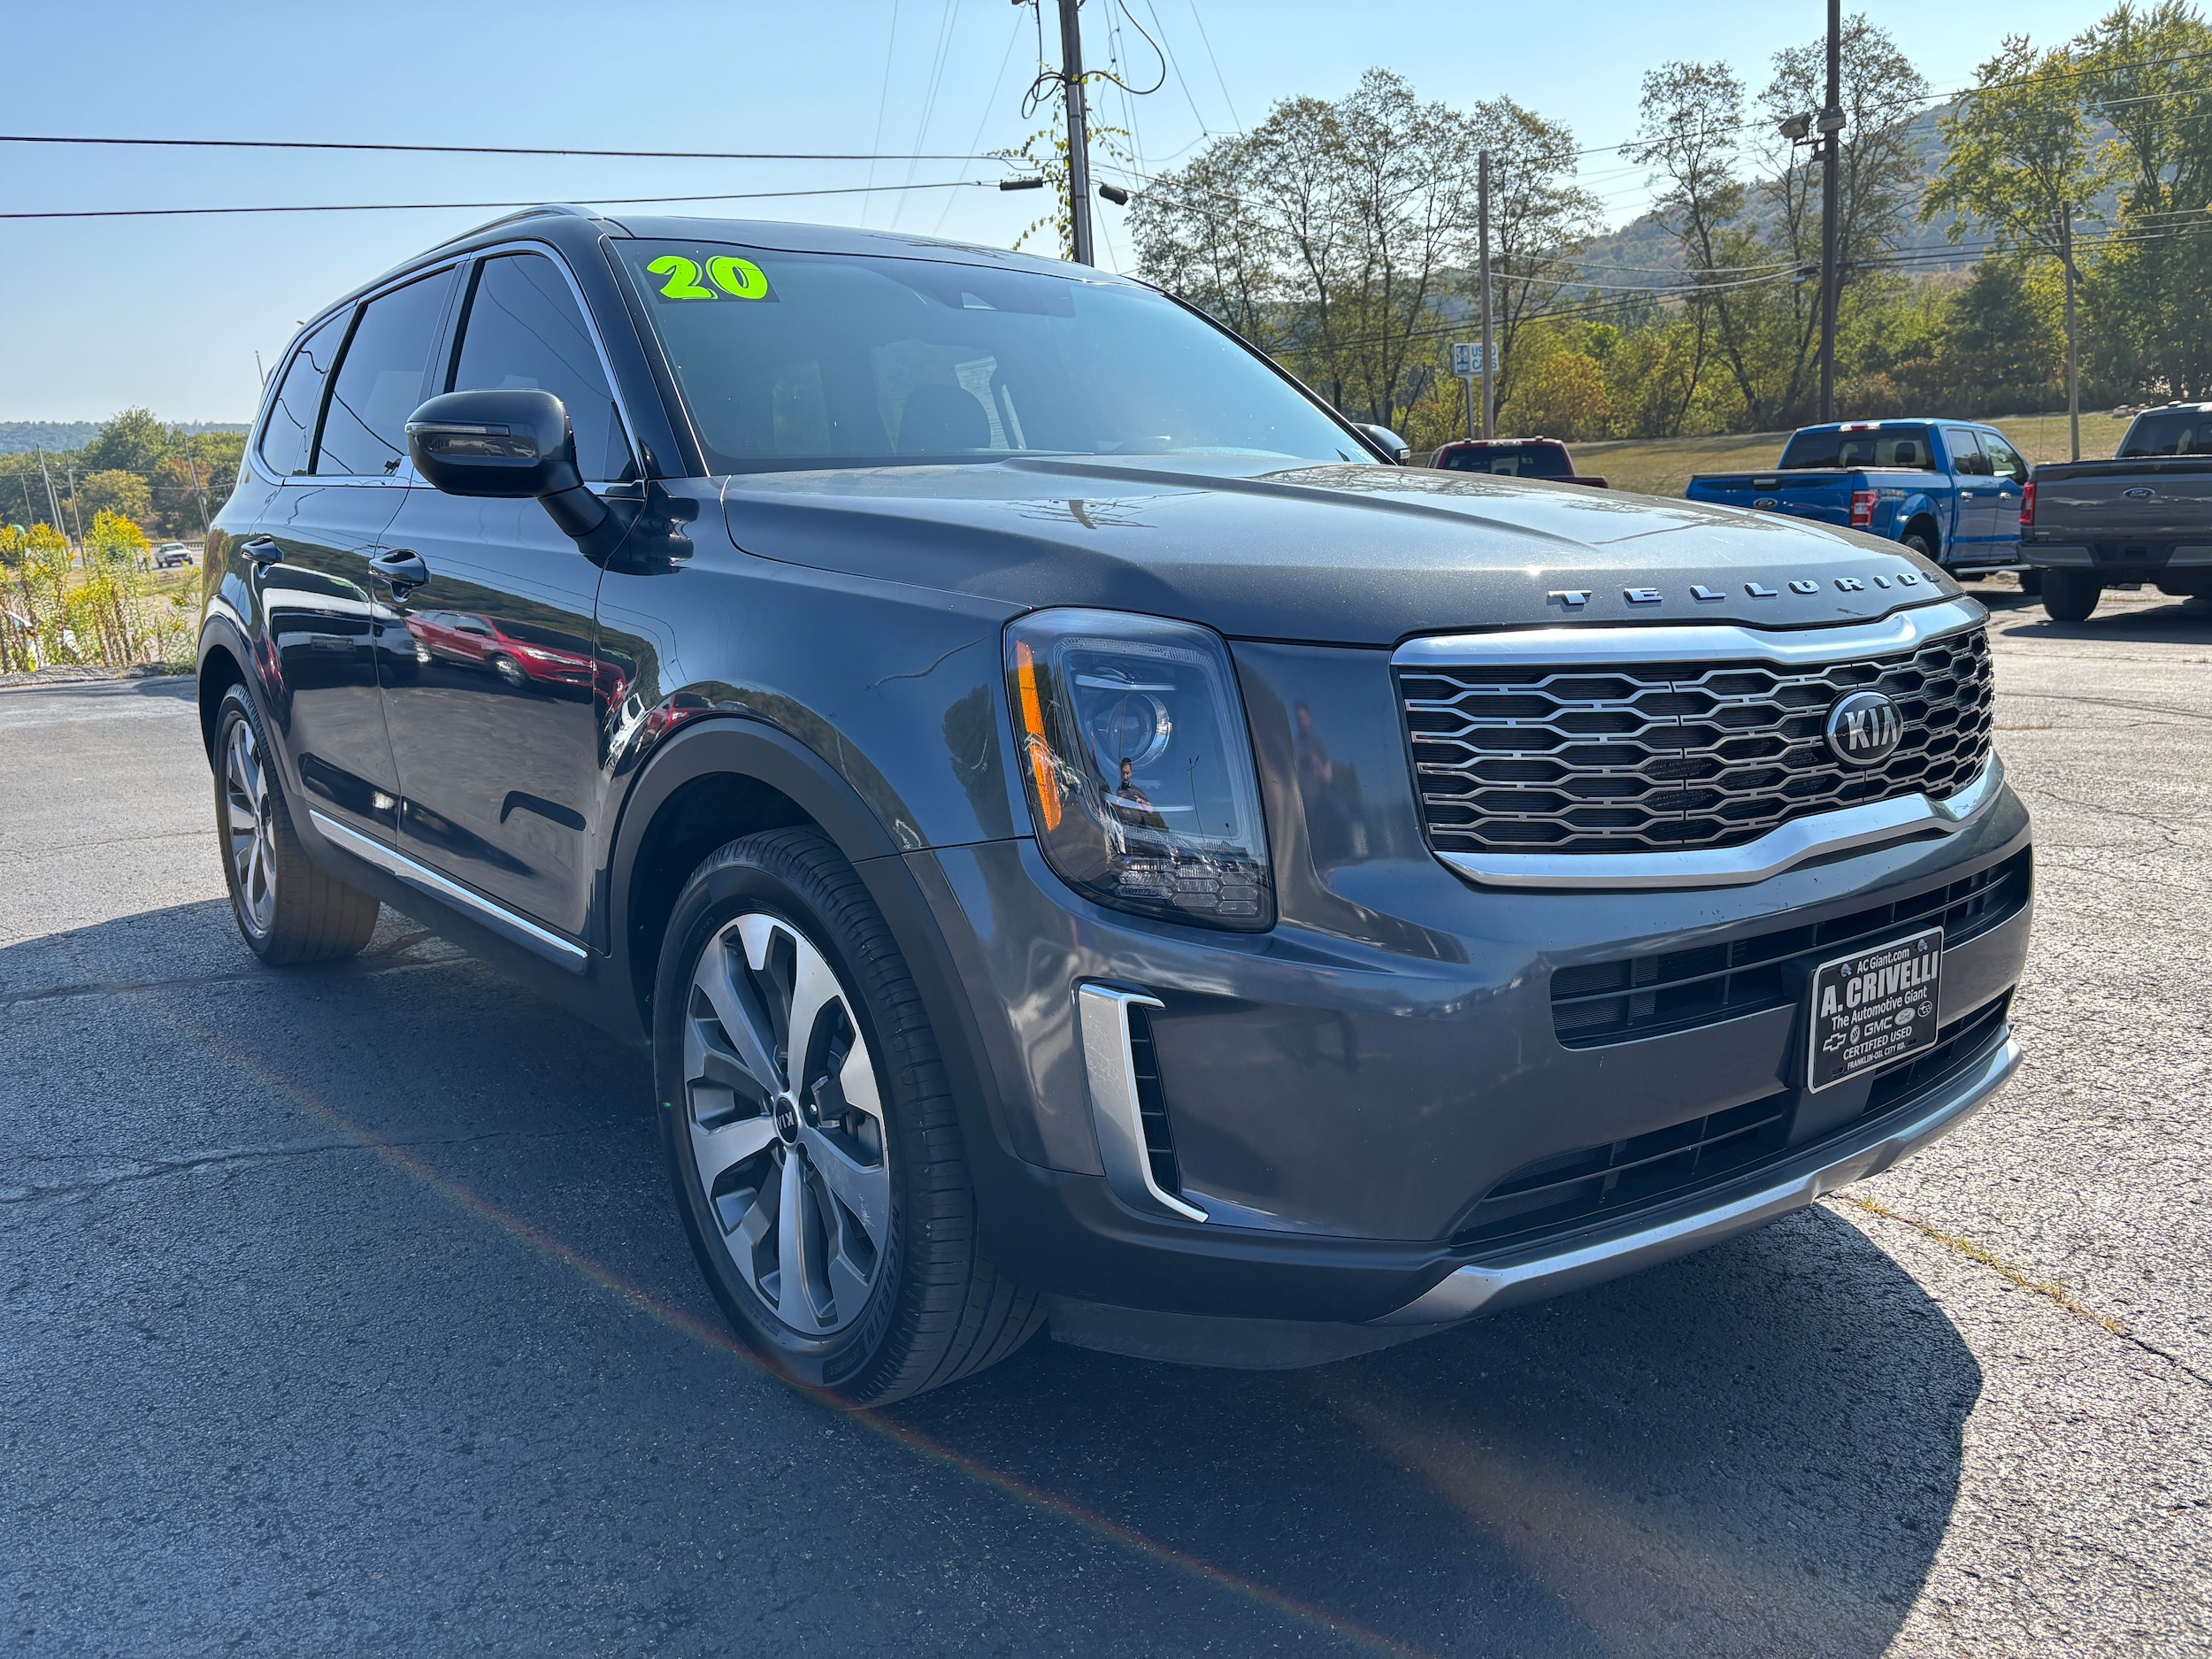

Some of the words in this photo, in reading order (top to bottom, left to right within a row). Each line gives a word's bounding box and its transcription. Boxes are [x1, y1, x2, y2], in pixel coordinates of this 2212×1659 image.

[647, 255, 768, 300] 20
[1471, 346, 1496, 357] USD
[1472, 358, 1497, 370] CAS
[1845, 706, 1897, 750] KIA
[1820, 985, 1843, 1018] A.
[1846, 950, 1939, 1009] CRIVELLI
[1832, 1014, 1849, 1031] The
[1850, 996, 1902, 1025] Automotive
[1904, 985, 1927, 1005] Giant
[1863, 1016, 1893, 1037] GMC
[1843, 1034, 1888, 1060] CERTIFIED
[1890, 1025, 1912, 1042] USED
[1847, 1053, 1884, 1071] FRANKLIN-OIL
[1884, 1044, 1897, 1056] CITY
[864, 1202, 901, 1346] MICHELIN
